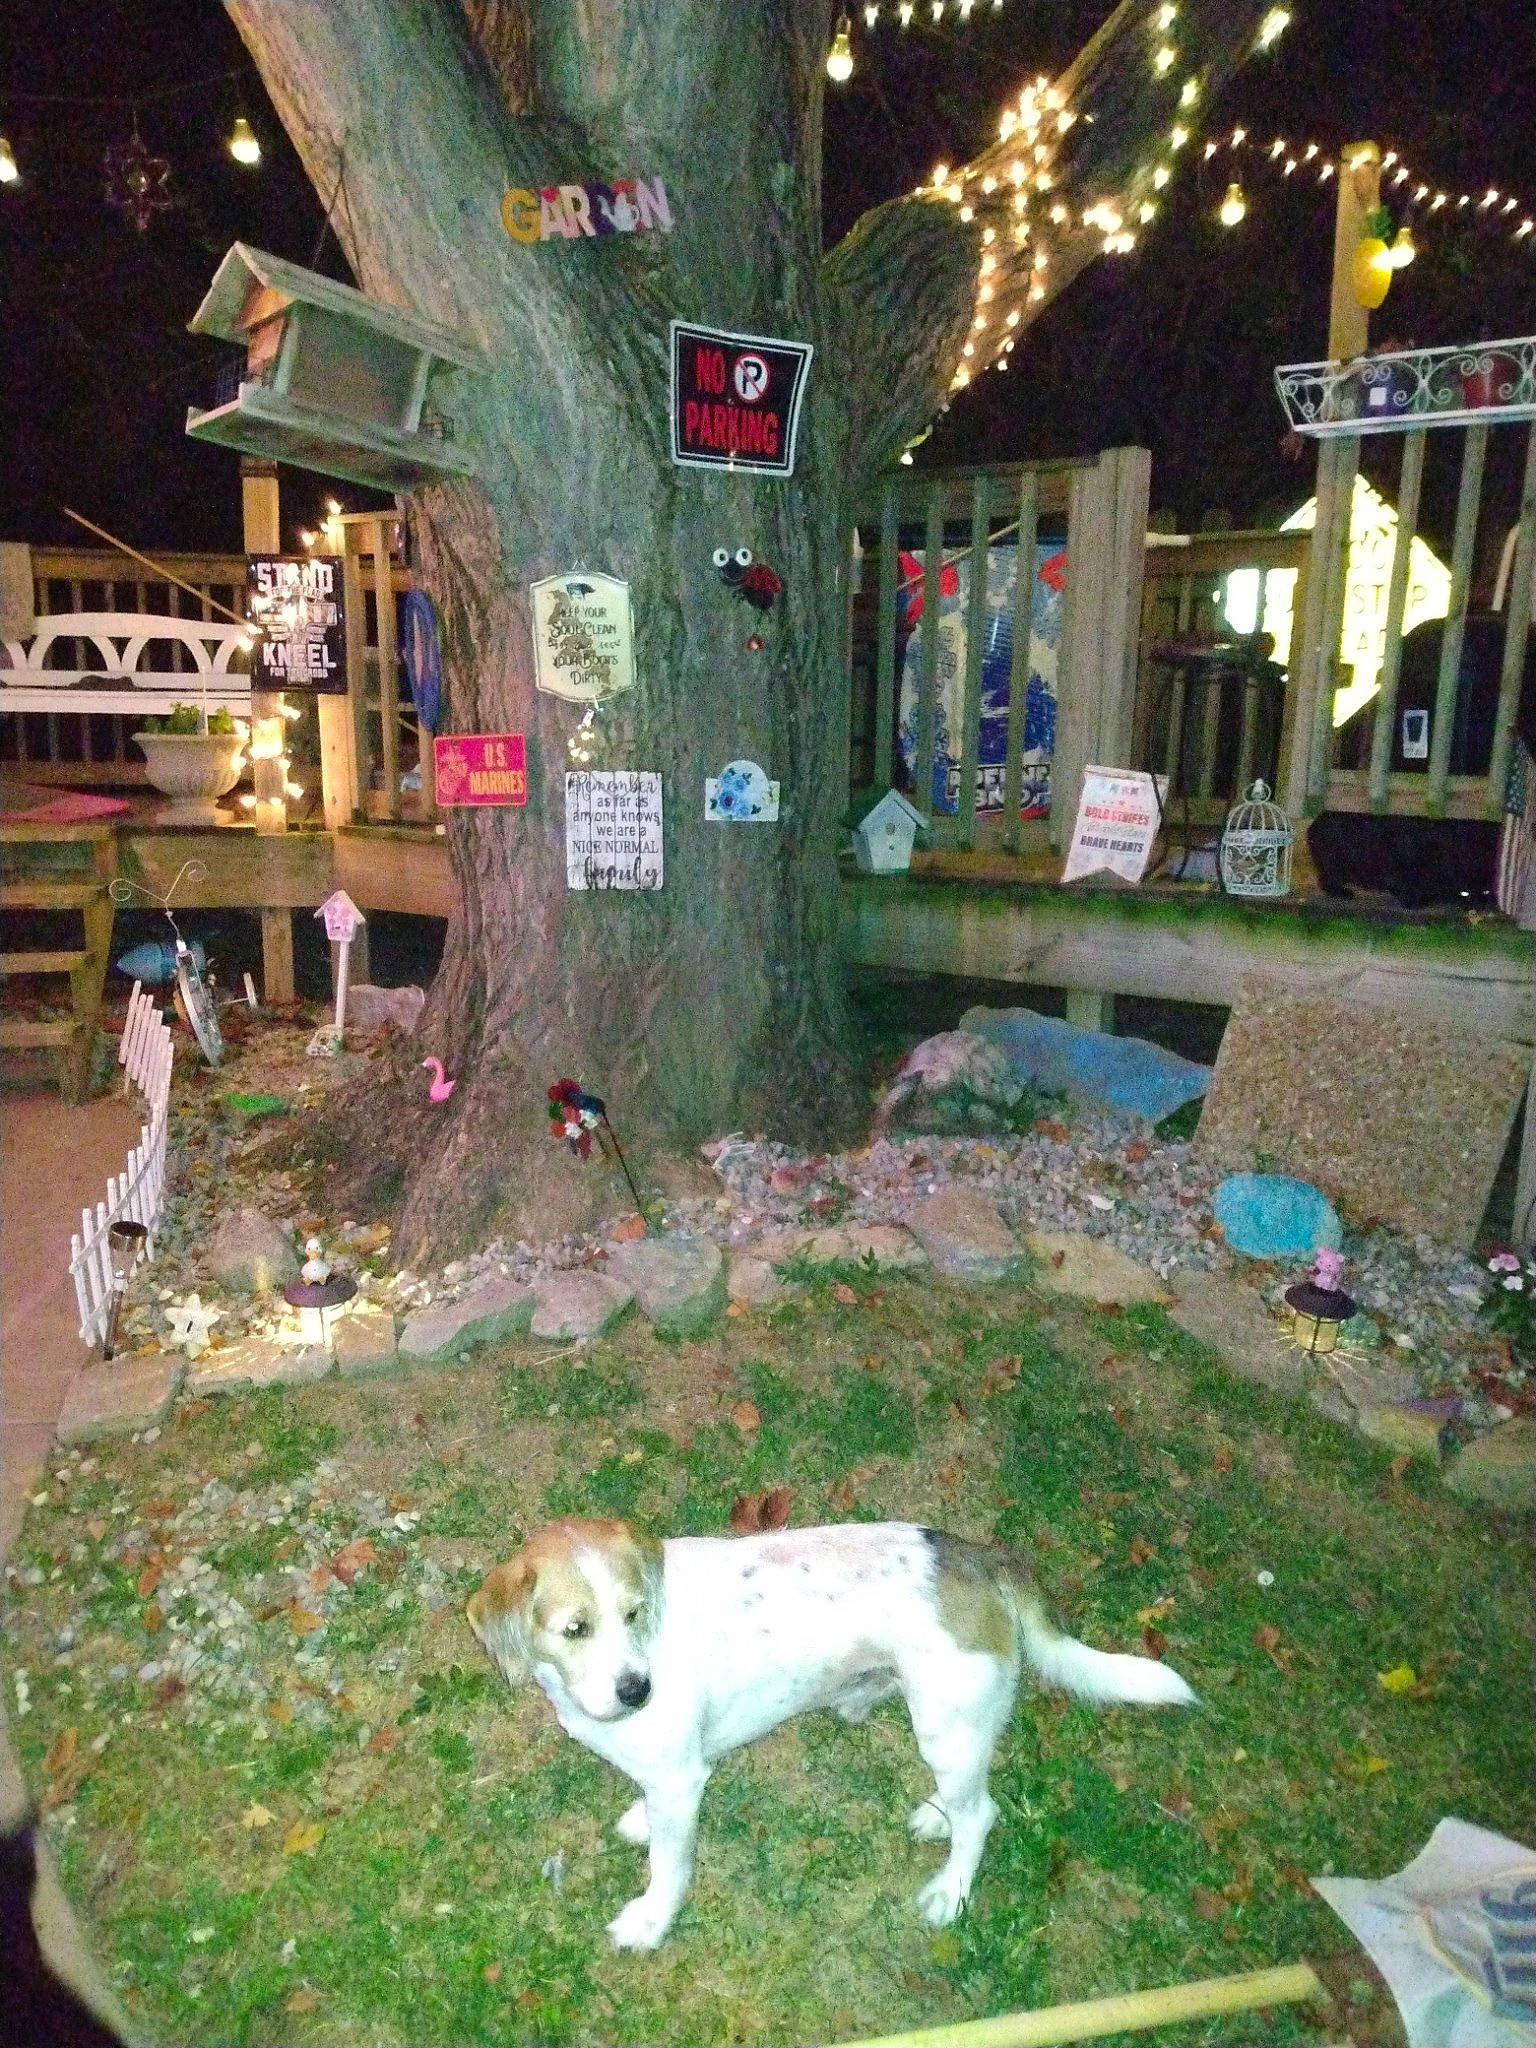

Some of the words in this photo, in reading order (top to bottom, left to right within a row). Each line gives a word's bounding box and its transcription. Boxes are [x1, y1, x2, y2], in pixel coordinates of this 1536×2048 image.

[501, 176, 676, 245] GARDN
[695, 347, 727, 395] NO
[684, 400, 779, 456] PARKING
[1352, 583, 1428, 614] STP
[584, 607, 607, 618] YOUR
[583, 621, 617, 638] CLEAN
[263, 642, 337, 668] KNEEL
[269, 667, 285, 677] FOR
[469, 770, 524, 795] MARINES
[597, 796, 611, 808] as
[614, 794, 631, 808] far
[635, 796, 649, 808] as
[573, 811, 616, 825] anyone
[596, 826, 613, 837] we
[617, 826, 636, 837] are
[639, 826, 647, 837] a
[572, 840, 601, 854] NICE
[605, 840, 659, 854] NORMAL
[1080, 834, 1110, 849] BRAVE
[1109, 839, 1145, 854] HEARTS
[583, 855, 660, 890] family
